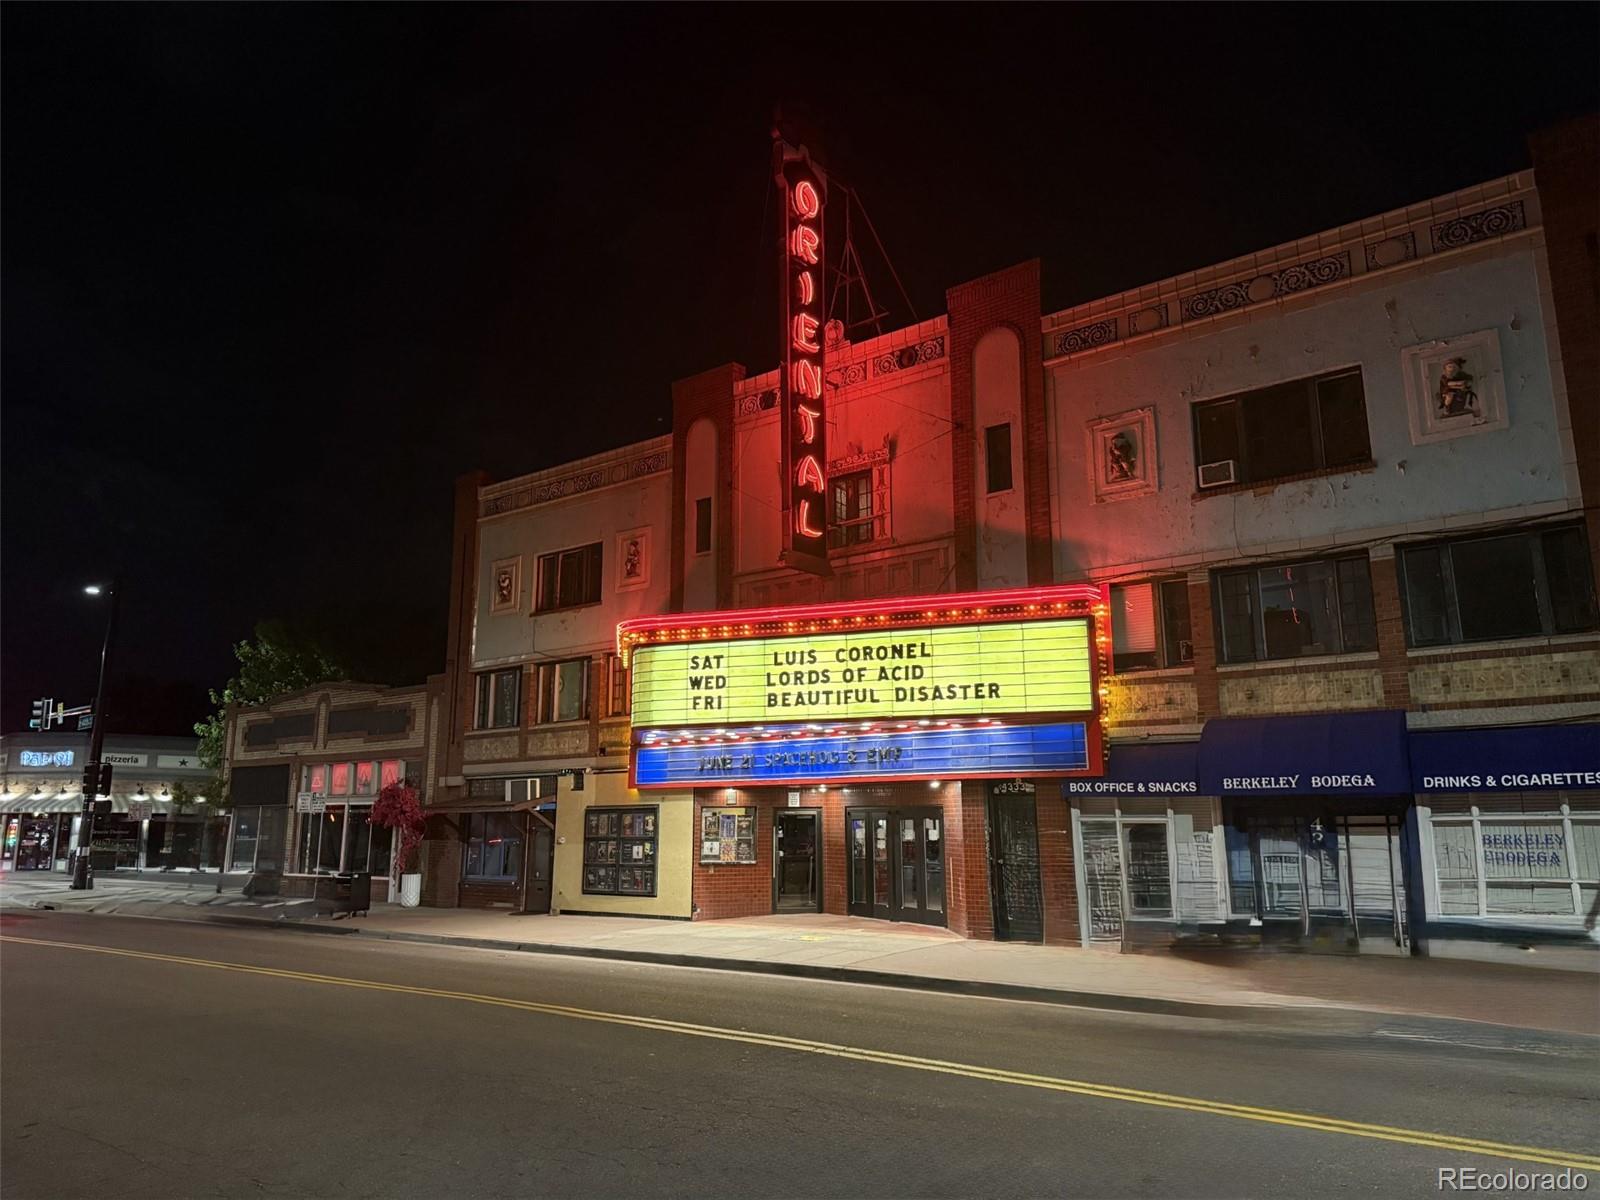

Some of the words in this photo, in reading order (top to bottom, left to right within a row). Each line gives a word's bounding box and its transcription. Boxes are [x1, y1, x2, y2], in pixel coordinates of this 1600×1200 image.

[790, 180, 824, 538] ORIENTAL
[690, 655, 724, 670] SAT
[773, 650, 817, 666] LUIS
[835, 642, 931, 663] CORONEL
[689, 675, 727, 690] WED
[766, 669, 831, 687] LORDS
[842, 667, 867, 683] OF
[878, 665, 924, 681] ACID
[692, 695, 722, 710] FRI
[767, 688, 880, 707] BEAUTIFUL
[895, 682, 1001, 702] DISASTER
[105, 755, 139, 764] pizzeria
[699, 755, 733, 771] JUNE
[742, 753, 756, 769] 21
[765, 751, 840, 767] SPACEHOG
[847, 750, 857, 763] &
[1069, 782, 1092, 792] BOX
[1094, 782, 1135, 793] OFFICE
[1137, 782, 1146, 792] &
[1148, 781, 1198, 792] SNACKS
[1223, 775, 1300, 789] BERKELEY
[1311, 775, 1376, 788] BODEGA
[1423, 775, 1481, 788] DRINKS
[1486, 775, 1497, 787] &
[1481, 833, 1565, 849] BERKELEY
